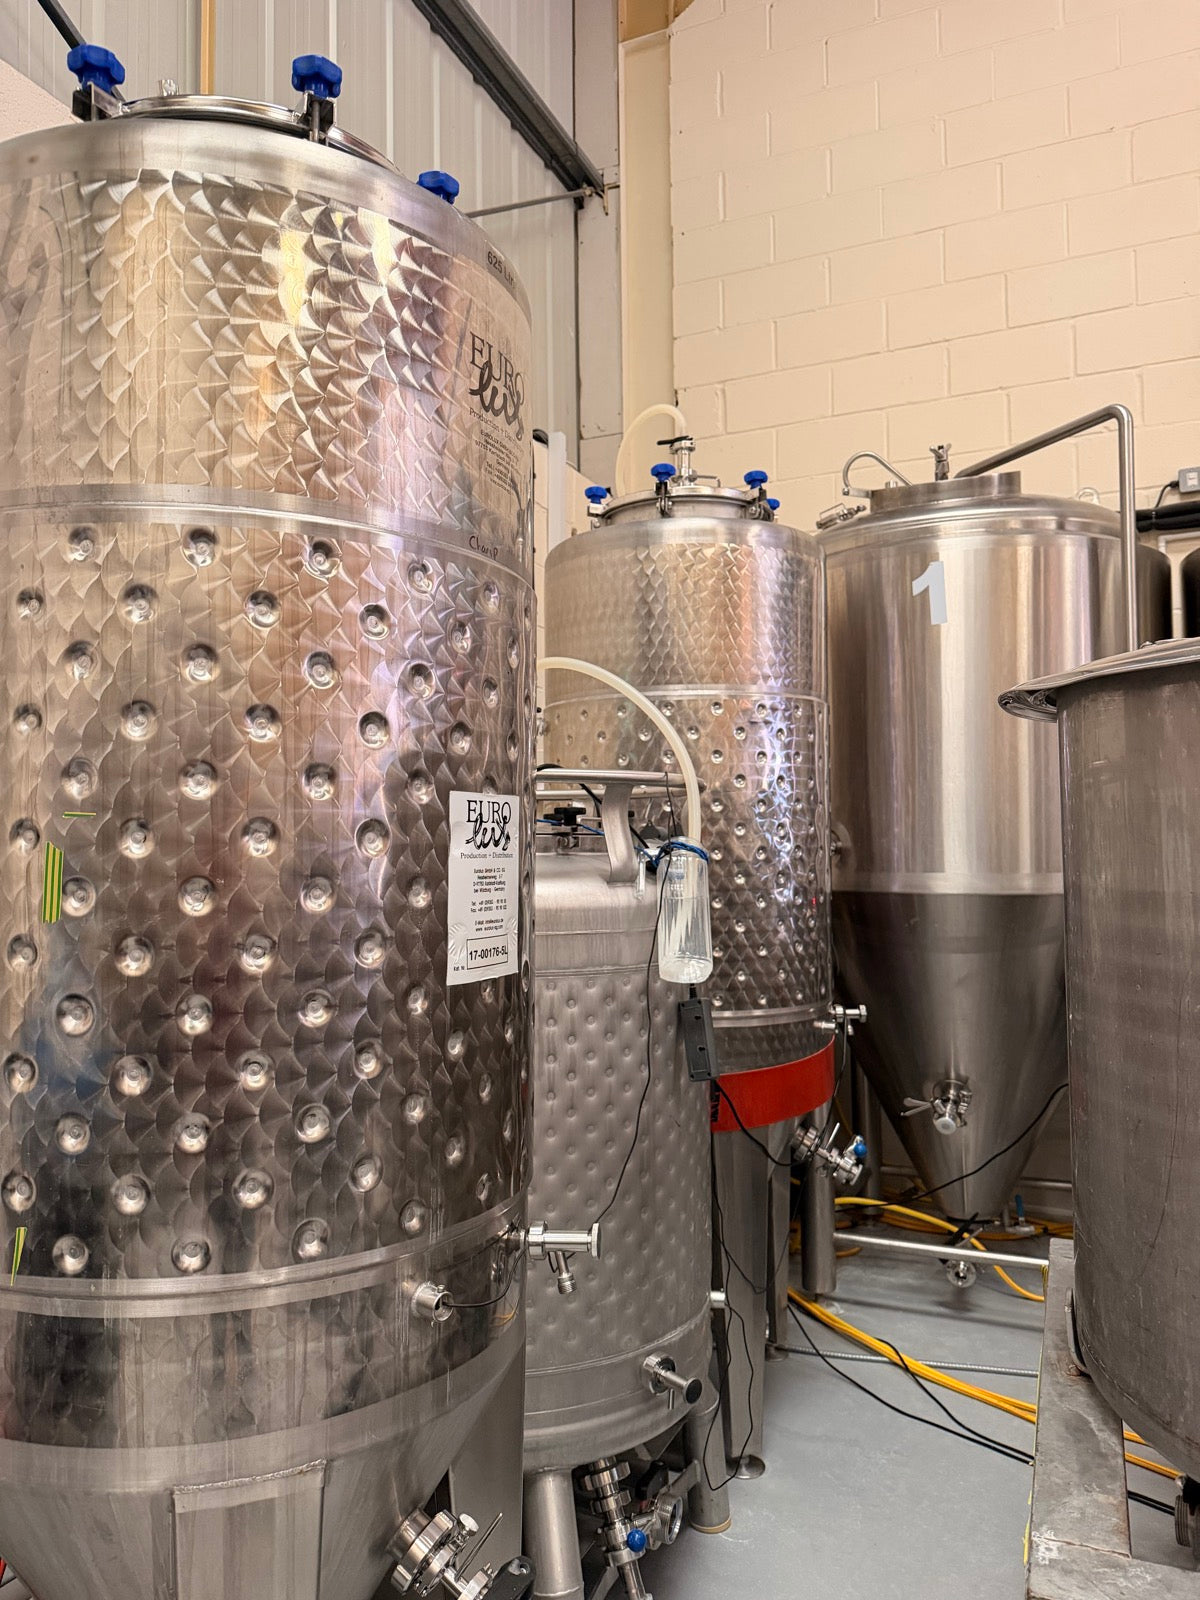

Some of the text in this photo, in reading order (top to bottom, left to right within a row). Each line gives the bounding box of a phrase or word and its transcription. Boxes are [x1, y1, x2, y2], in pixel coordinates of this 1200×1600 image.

[487, 250, 503, 274] 625
[469, 331, 525, 406] EURO
[912, 560, 947, 625] 1
[465, 799, 512, 825] EURO
[460, 852, 488, 860] Production
[469, 945, 508, 961] 17-00176-5L
